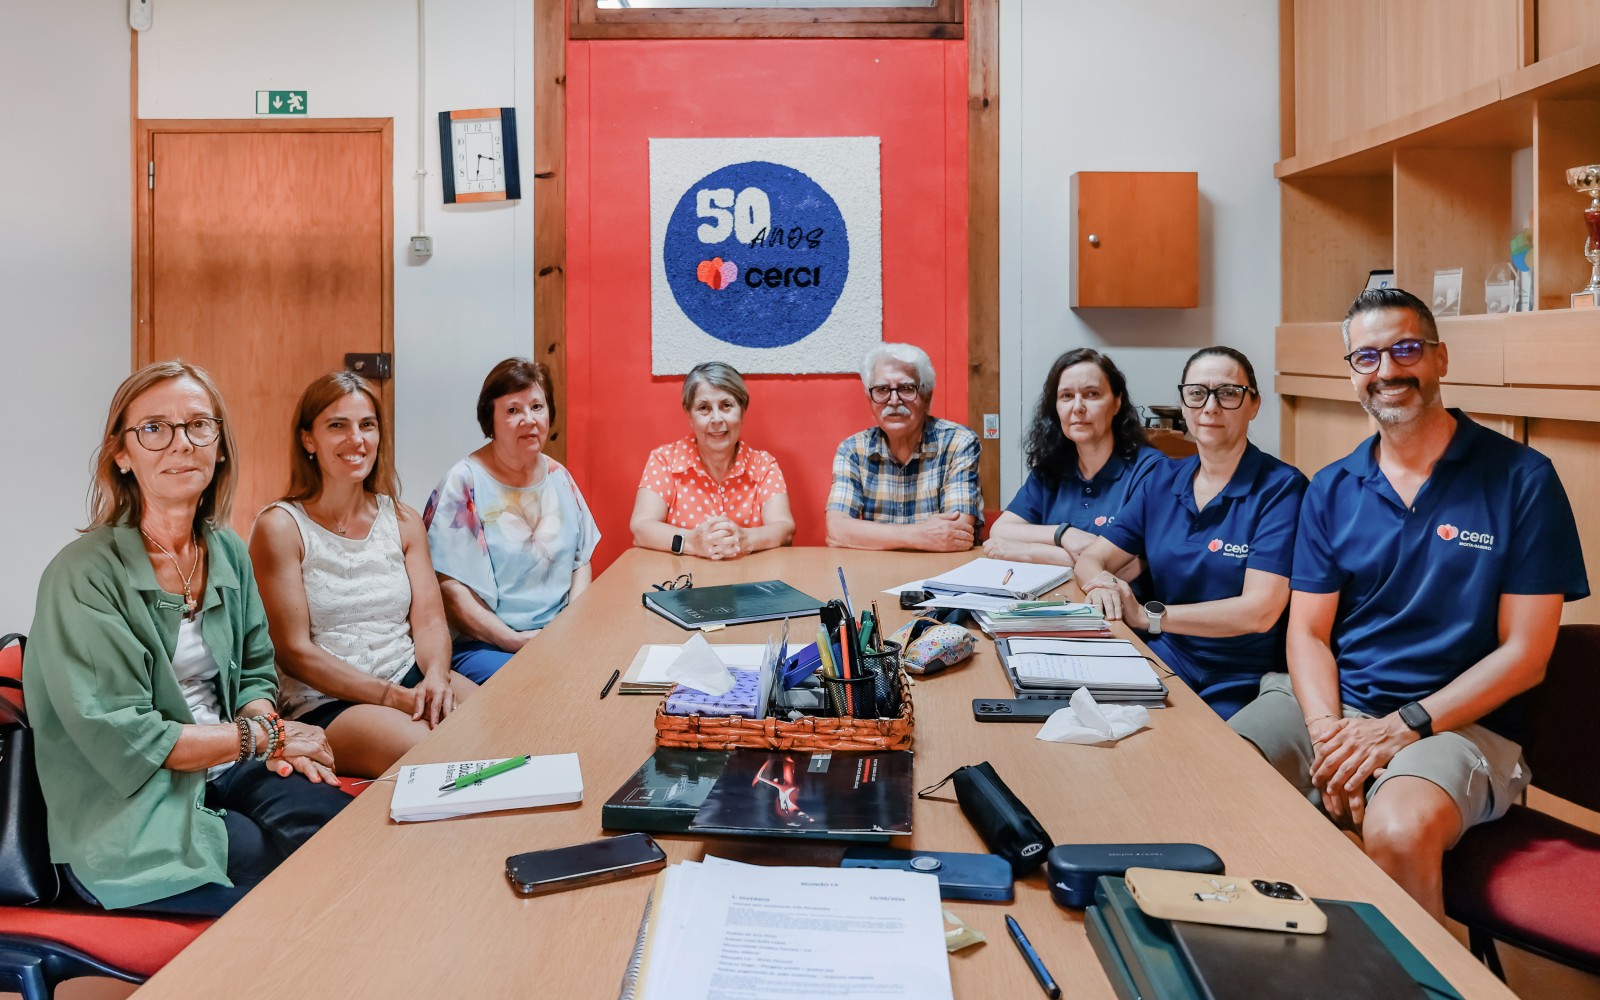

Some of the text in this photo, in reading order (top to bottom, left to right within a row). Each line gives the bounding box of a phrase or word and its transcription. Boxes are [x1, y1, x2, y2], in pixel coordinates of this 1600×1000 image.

[474, 123, 482, 132] 12
[696, 186, 771, 244] 50
[750, 227, 825, 249] ANOS
[1022, 844, 1041, 856] IKEA
